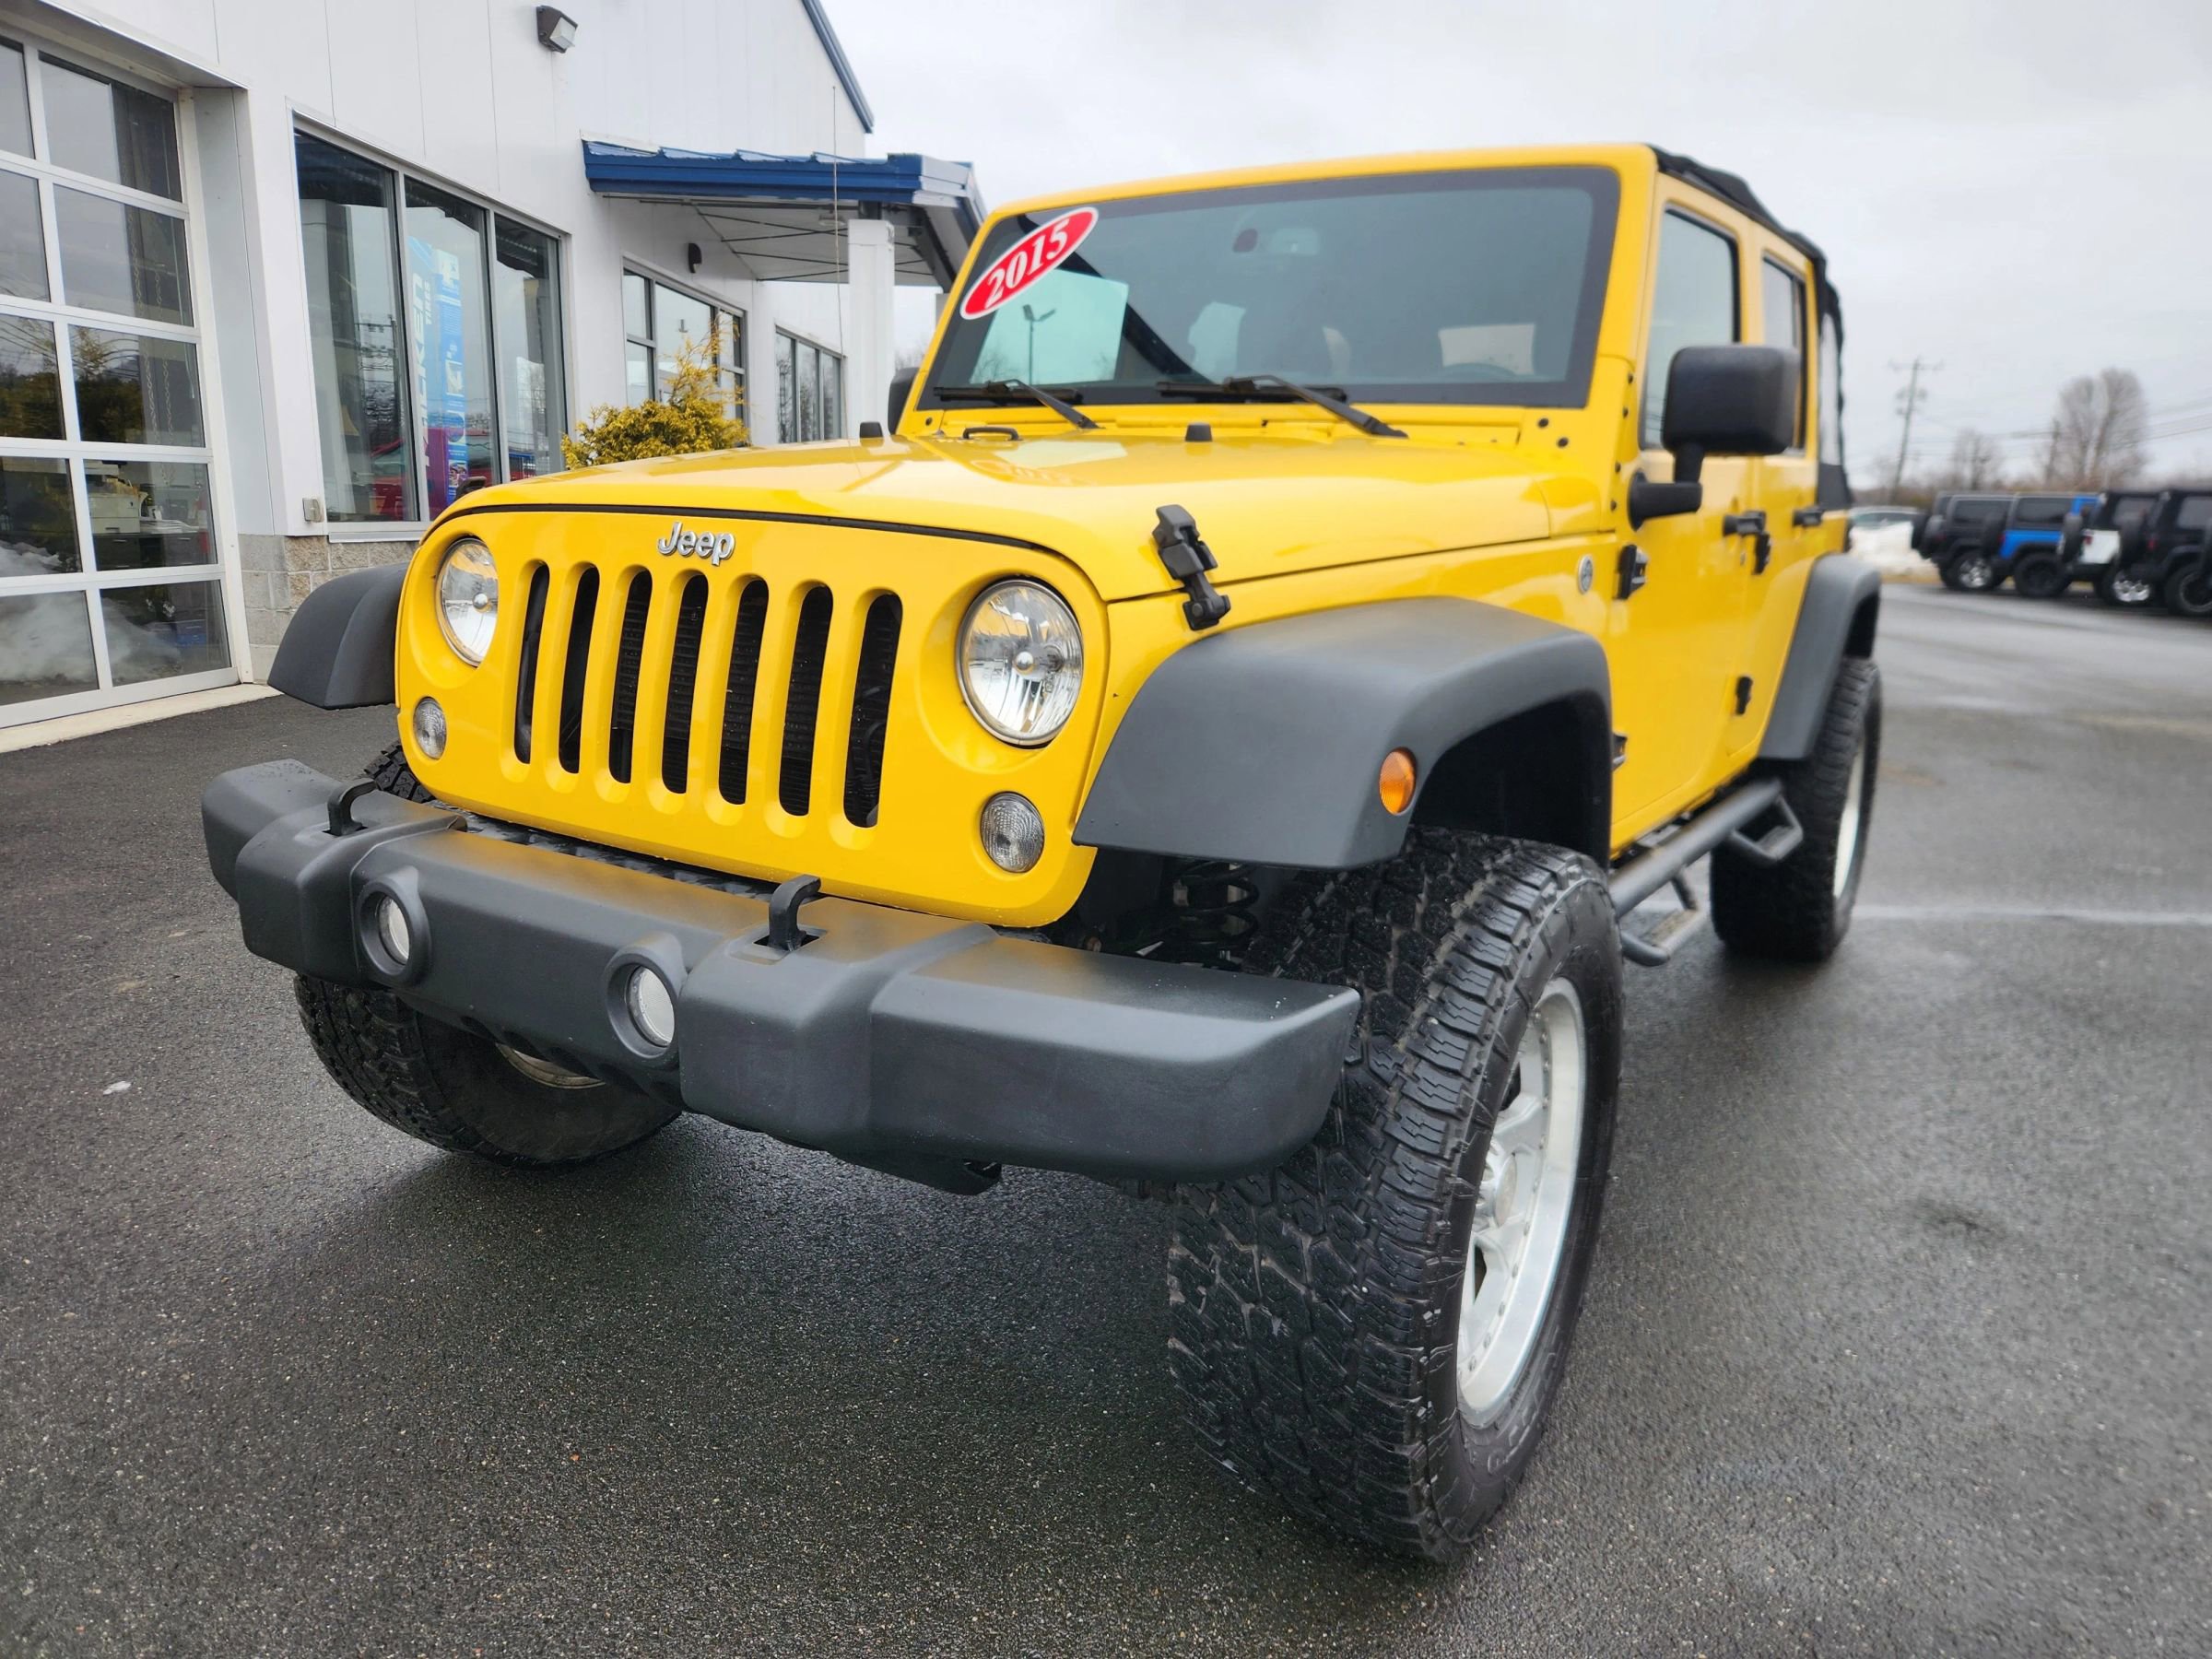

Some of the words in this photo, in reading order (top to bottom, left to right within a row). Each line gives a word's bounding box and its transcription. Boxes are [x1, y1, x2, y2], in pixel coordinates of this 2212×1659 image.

[984, 218, 1070, 310] 2015
[424, 279, 432, 324] TIRES
[658, 522, 735, 567] Jeep
